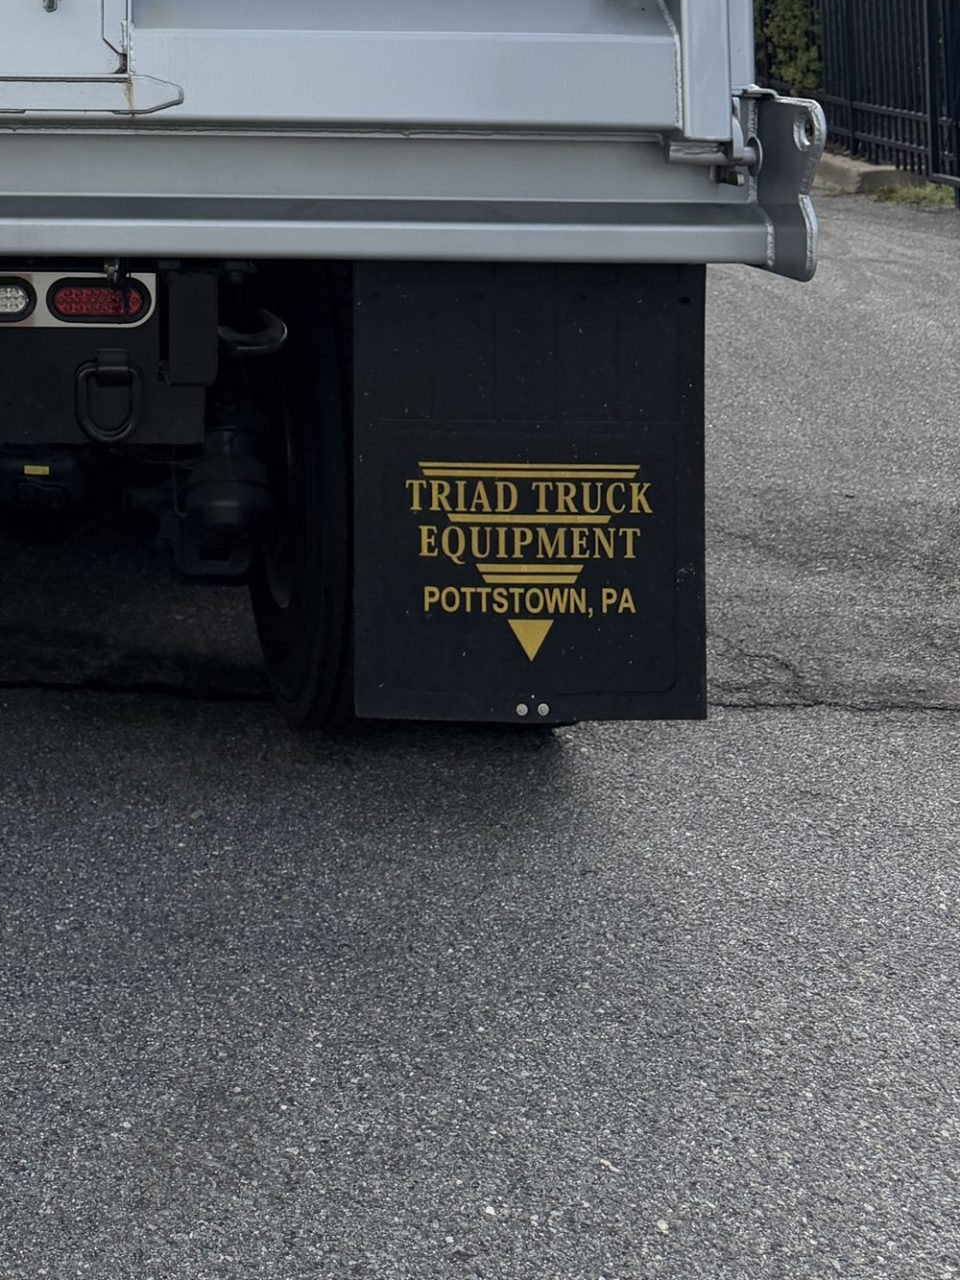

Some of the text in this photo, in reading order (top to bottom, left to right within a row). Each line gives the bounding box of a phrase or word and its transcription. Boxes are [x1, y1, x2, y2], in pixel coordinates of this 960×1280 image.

[405, 480, 654, 514] TRIAD TRUCK
[418, 525, 641, 565] EQUIPMENT
[423, 586, 637, 618] POTTSTOWN, PA
